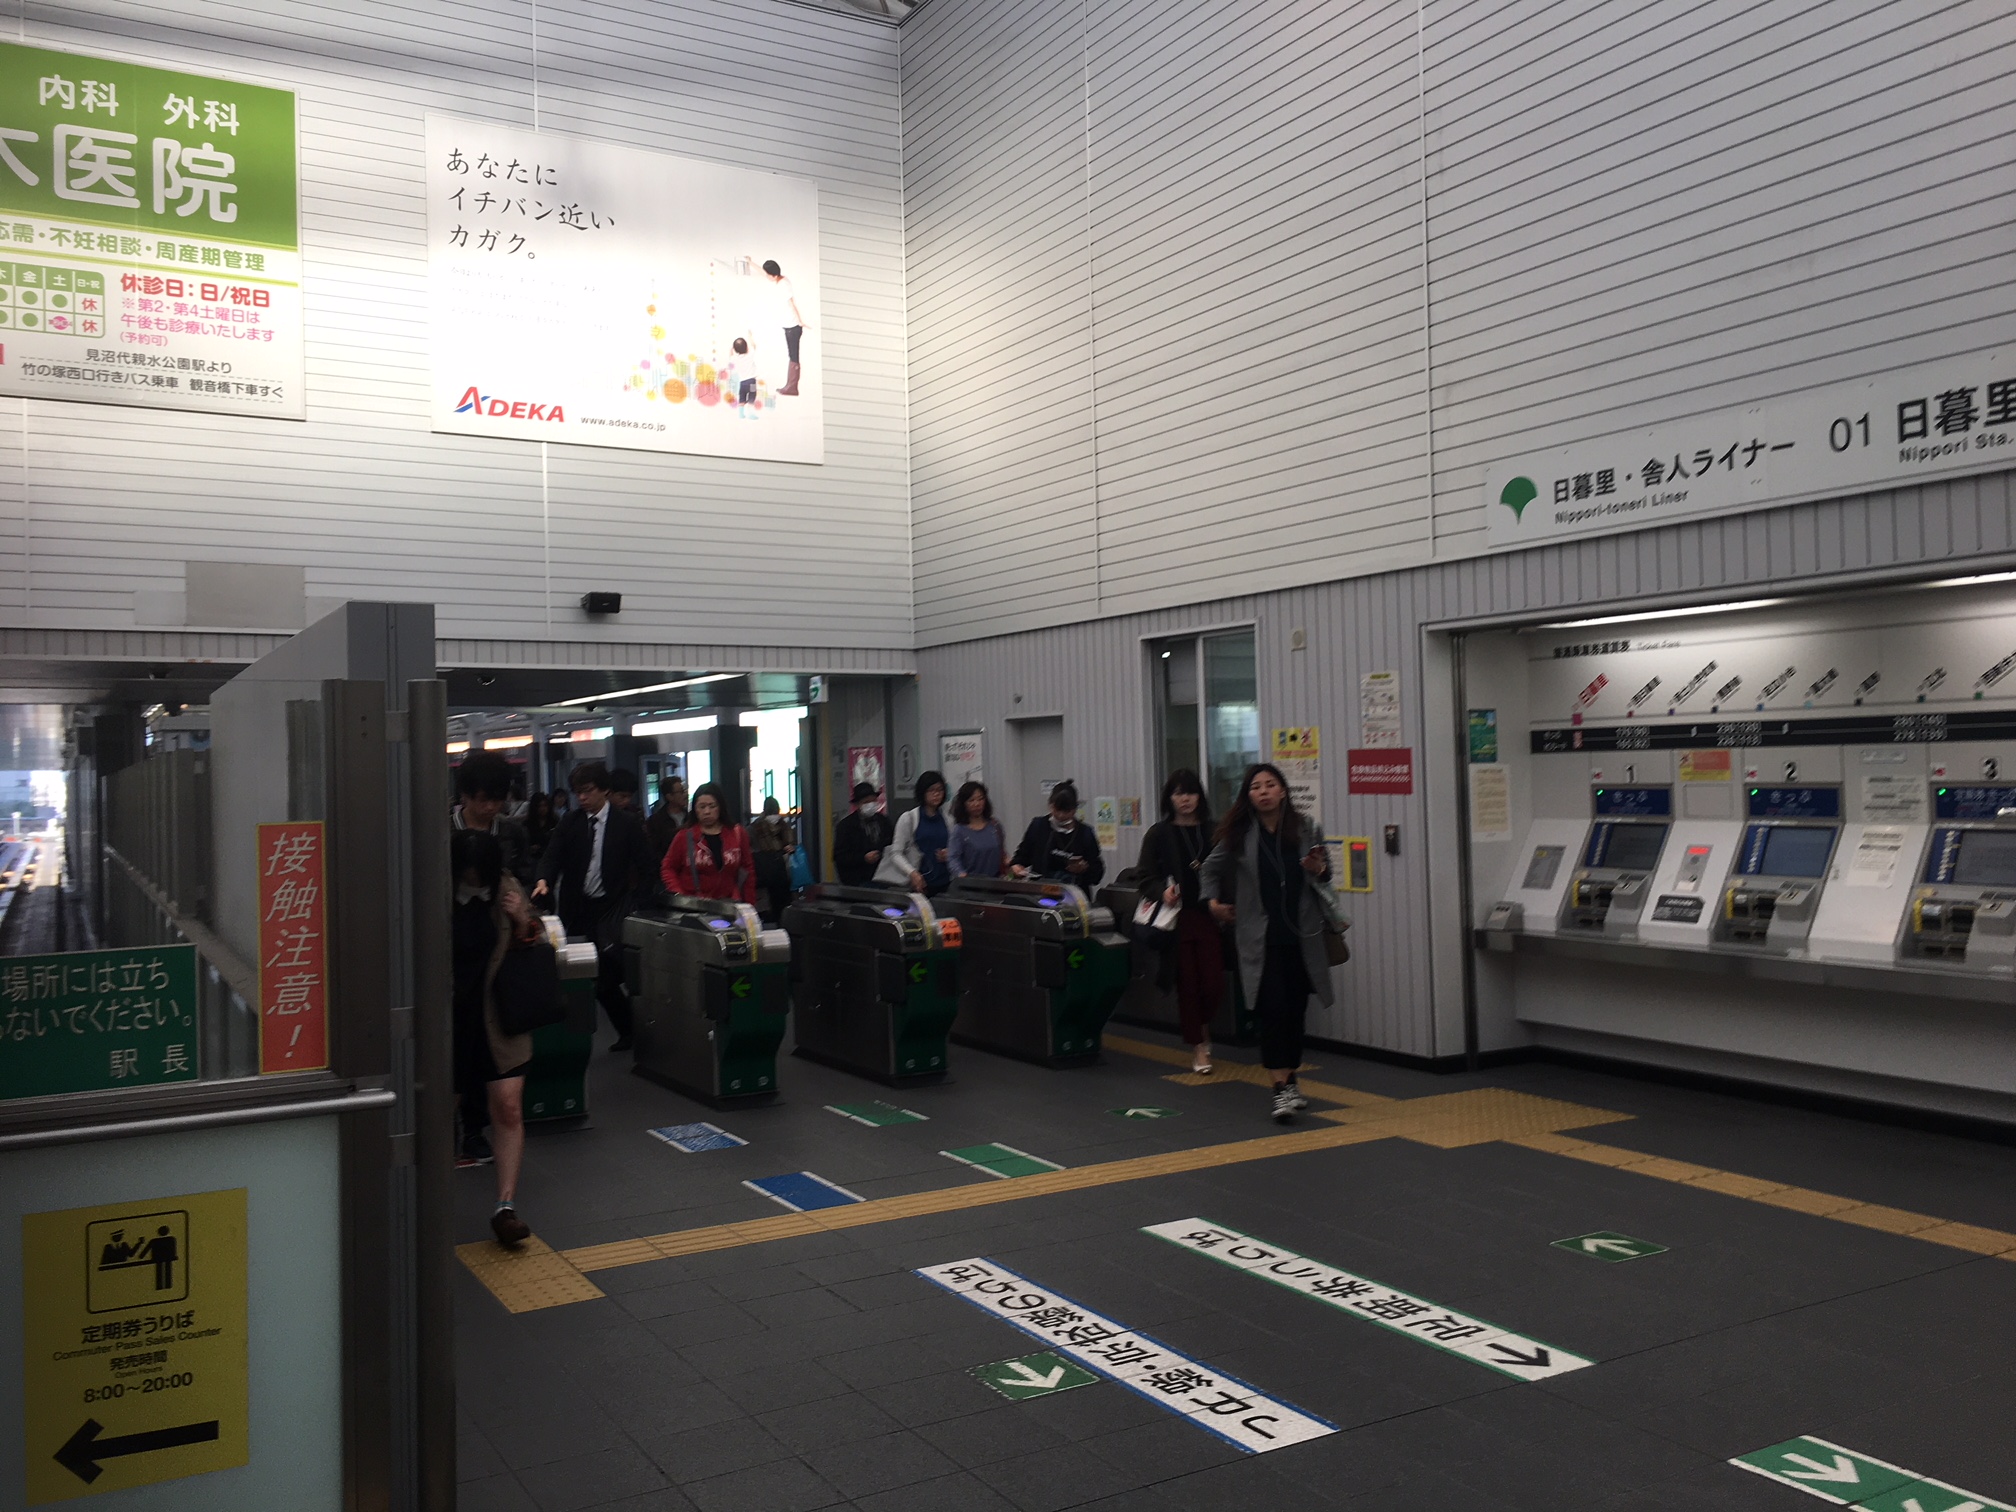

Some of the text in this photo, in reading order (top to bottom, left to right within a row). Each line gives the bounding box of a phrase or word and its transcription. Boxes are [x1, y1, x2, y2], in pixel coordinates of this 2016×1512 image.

[39, 74, 240, 136] 内科 外科
[447, 147, 558, 187] あなたに
[449, 186, 615, 231] イチバン近い
[449, 224, 536, 260] カガク。
[23, 271, 37, 284] 金
[52, 274, 67, 287] 土
[81, 297, 98, 311] 休
[81, 319, 98, 333] 休
[120, 313, 275, 342] 午後も診療いたします
[85, 349, 232, 374] 見沼代親水公園駅より
[22, 363, 284, 398] 竹の塚西口行きバス乗車 観音橋下車すぐ
[454, 386, 565, 422] ADEKA
[1829, 377, 2016, 453] 01 日暮里
[581, 417, 666, 431] www.adeka.co.jp
[1899, 432, 2014, 463] Nippori Sta.
[1553, 438, 1795, 505] 日暮里・舎人ライナー
[1652, 490, 1689, 507] Liner
[1625, 765, 1635, 782] 1
[1785, 762, 1797, 781] 2
[2, 957, 170, 1002] 場所には立ち
[0, 996, 192, 1041] ないでください。
[1179, 1227, 1487, 1342] 定期券うりば
[53, 1327, 222, 1361] Commuter Pass Sales Counter
[81, 1310, 195, 1344] 定期券うりば
[110, 1350, 167, 1371] 発売時間
[940, 1264, 1279, 1439] JR線・京成線のりば
[139, 1366, 163, 1375] Hours
